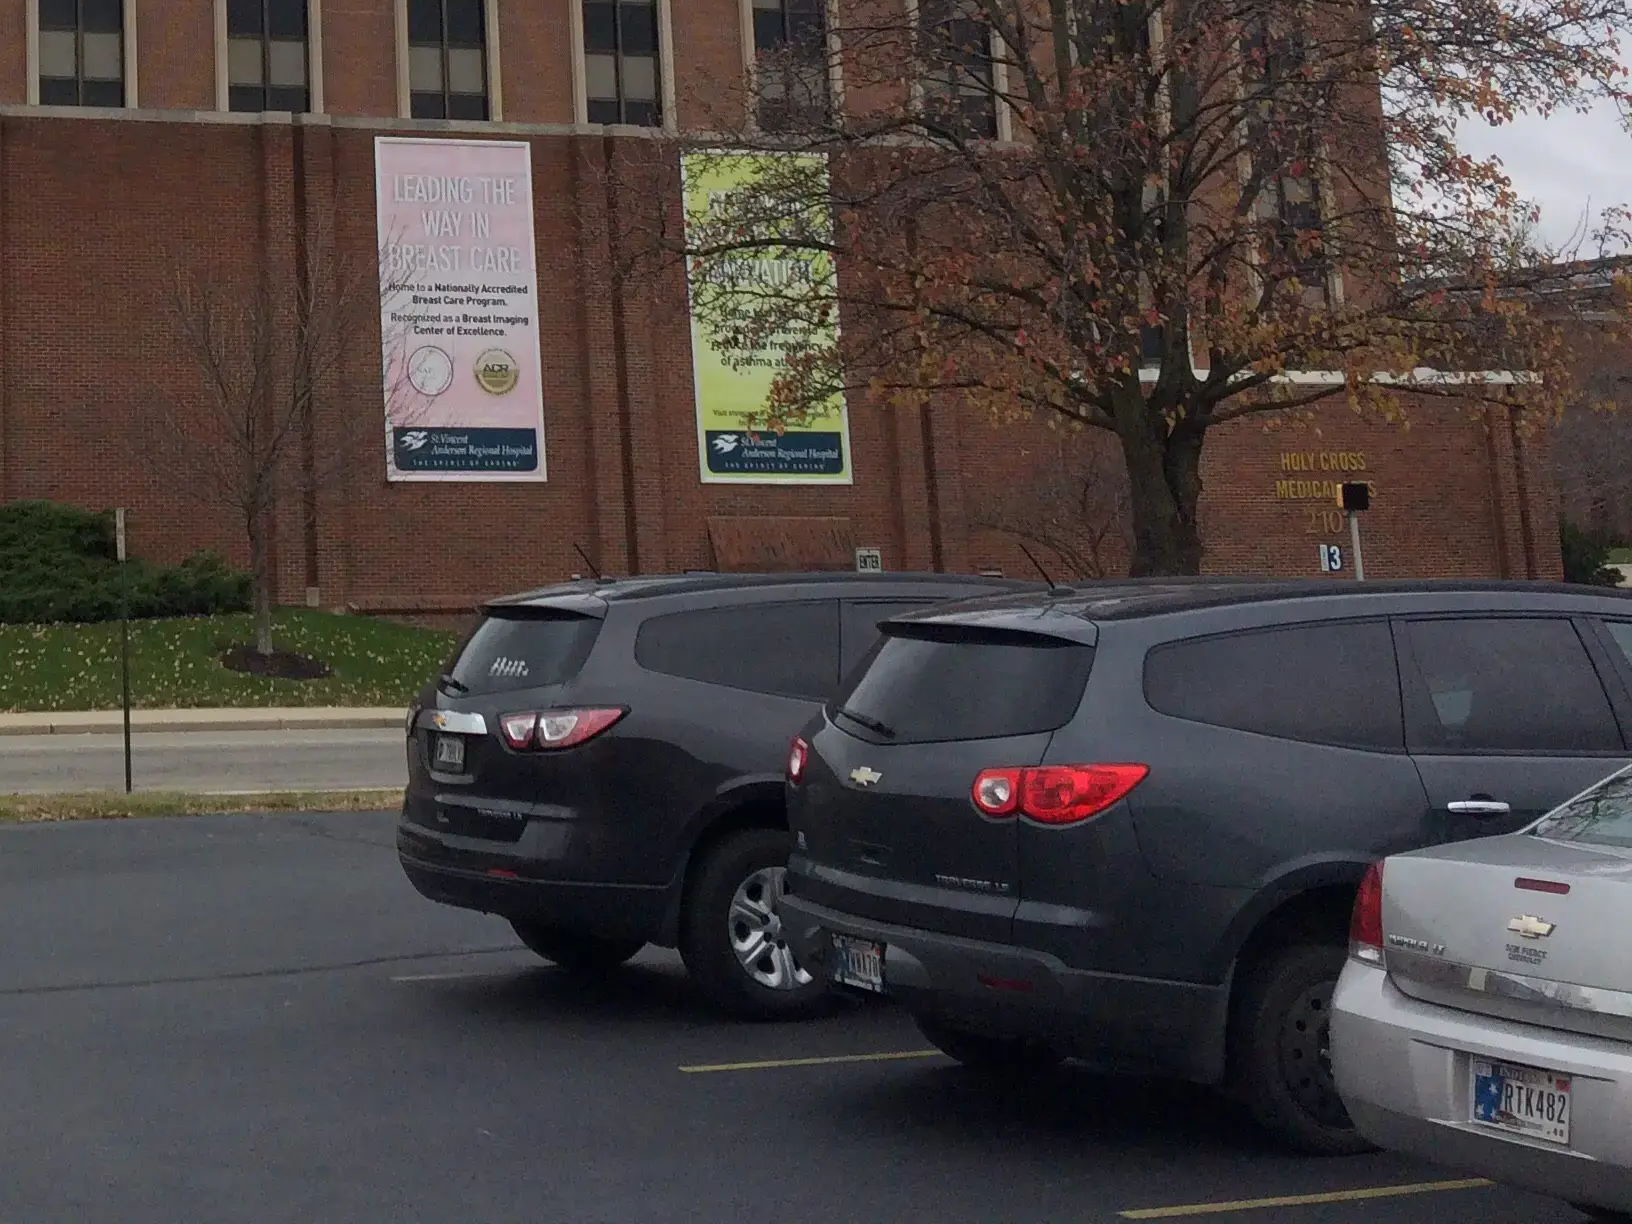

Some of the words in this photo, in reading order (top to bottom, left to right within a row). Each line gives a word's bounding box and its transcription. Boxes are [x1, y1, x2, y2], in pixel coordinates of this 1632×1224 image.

[394, 174, 472, 204] LEADING
[480, 177, 515, 205] THE
[422, 210, 461, 237] WAY
[471, 212, 489, 238] IN
[388, 243, 461, 272] BREAST
[389, 283, 415, 292] Home
[417, 283, 425, 292] to
[434, 283, 479, 295] Nationally
[481, 284, 528, 294] Accredited
[412, 295, 441, 304] Breast
[443, 296, 464, 305] Care
[466, 296, 508, 307] Program.
[391, 313, 441, 324] Recognized
[443, 315, 453, 323] as
[455, 315, 460, 323] a
[462, 314, 491, 324] Breast
[493, 315, 529, 326] Imaging
[414, 326, 444, 335] Center
[446, 326, 455, 335] of
[457, 327, 508, 336] Excellence.
[483, 363, 509, 373] ACR
[720, 356, 731, 366] of
[734, 356, 772, 367] asthma
[431, 445, 467, 456] Anderson
[468, 445, 500, 458] Regional
[502, 445, 533, 457] Hospital
[741, 448, 776, 458] Anderson
[777, 448, 807, 461] Regional
[809, 448, 838, 460] Hospital
[1280, 452, 1315, 471] HOLY
[1319, 452, 1366, 471] CROSS
[1306, 510, 1344, 533] 210
[1329, 545, 1342, 570] 3
[1504, 1083, 1566, 1124] RTK482
